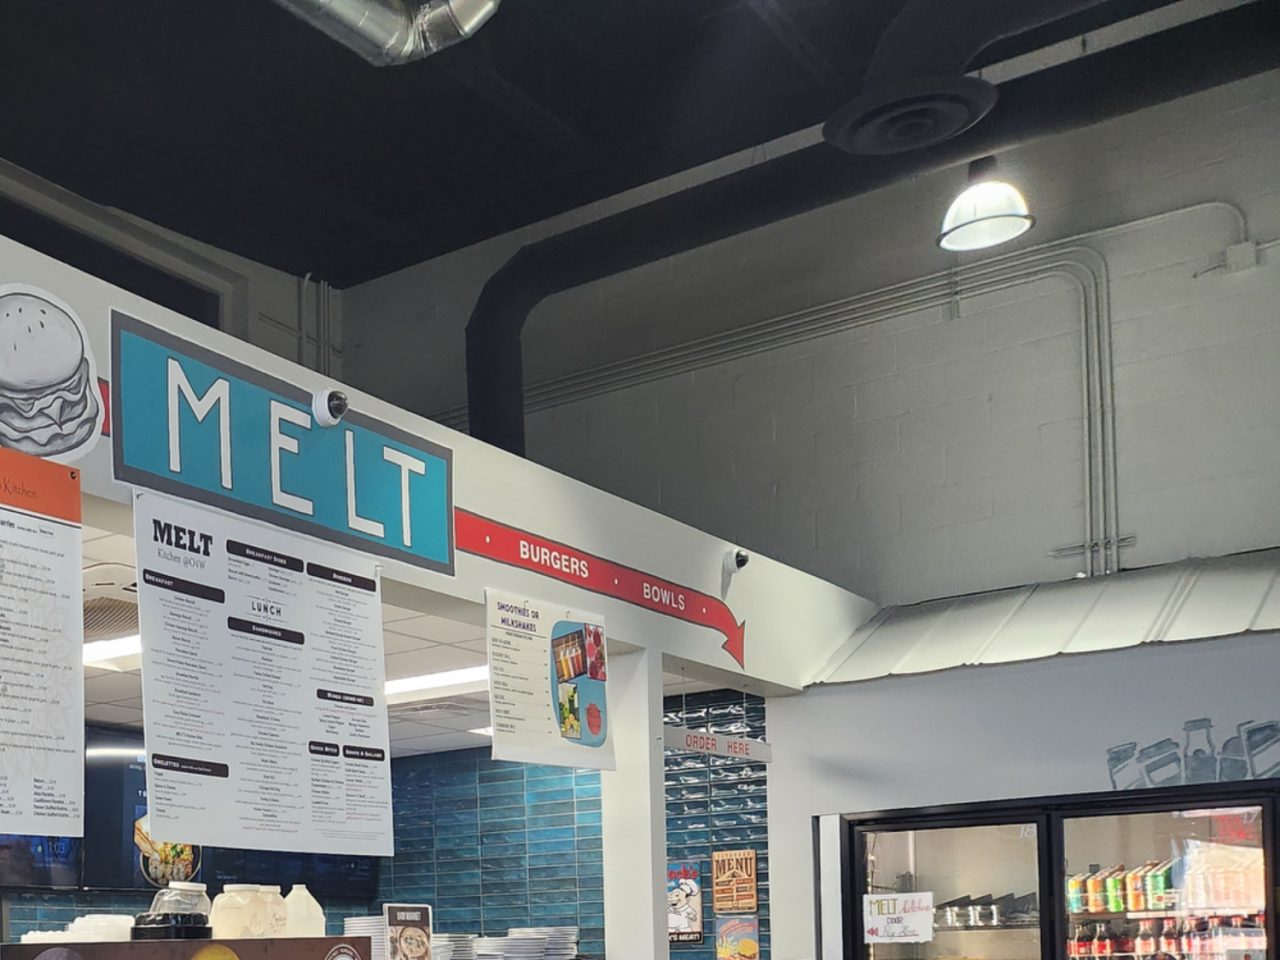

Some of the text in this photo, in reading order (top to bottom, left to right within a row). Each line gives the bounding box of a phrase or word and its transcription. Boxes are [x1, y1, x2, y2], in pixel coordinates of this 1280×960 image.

[167, 356, 426, 548] MELT
[3, 476, 38, 500] Kitchen
[152, 519, 213, 557] MELT
[519, 540, 589, 578] BURGERS
[643, 582, 685, 610] BOWLS
[252, 601, 282, 616] LUNCH
[497, 601, 540, 619] SMOOTHIES OR
[501, 617, 537, 632] MILKSHAKES
[685, 733, 750, 755] ORDER HERE
[715, 857, 752, 879] MENU
